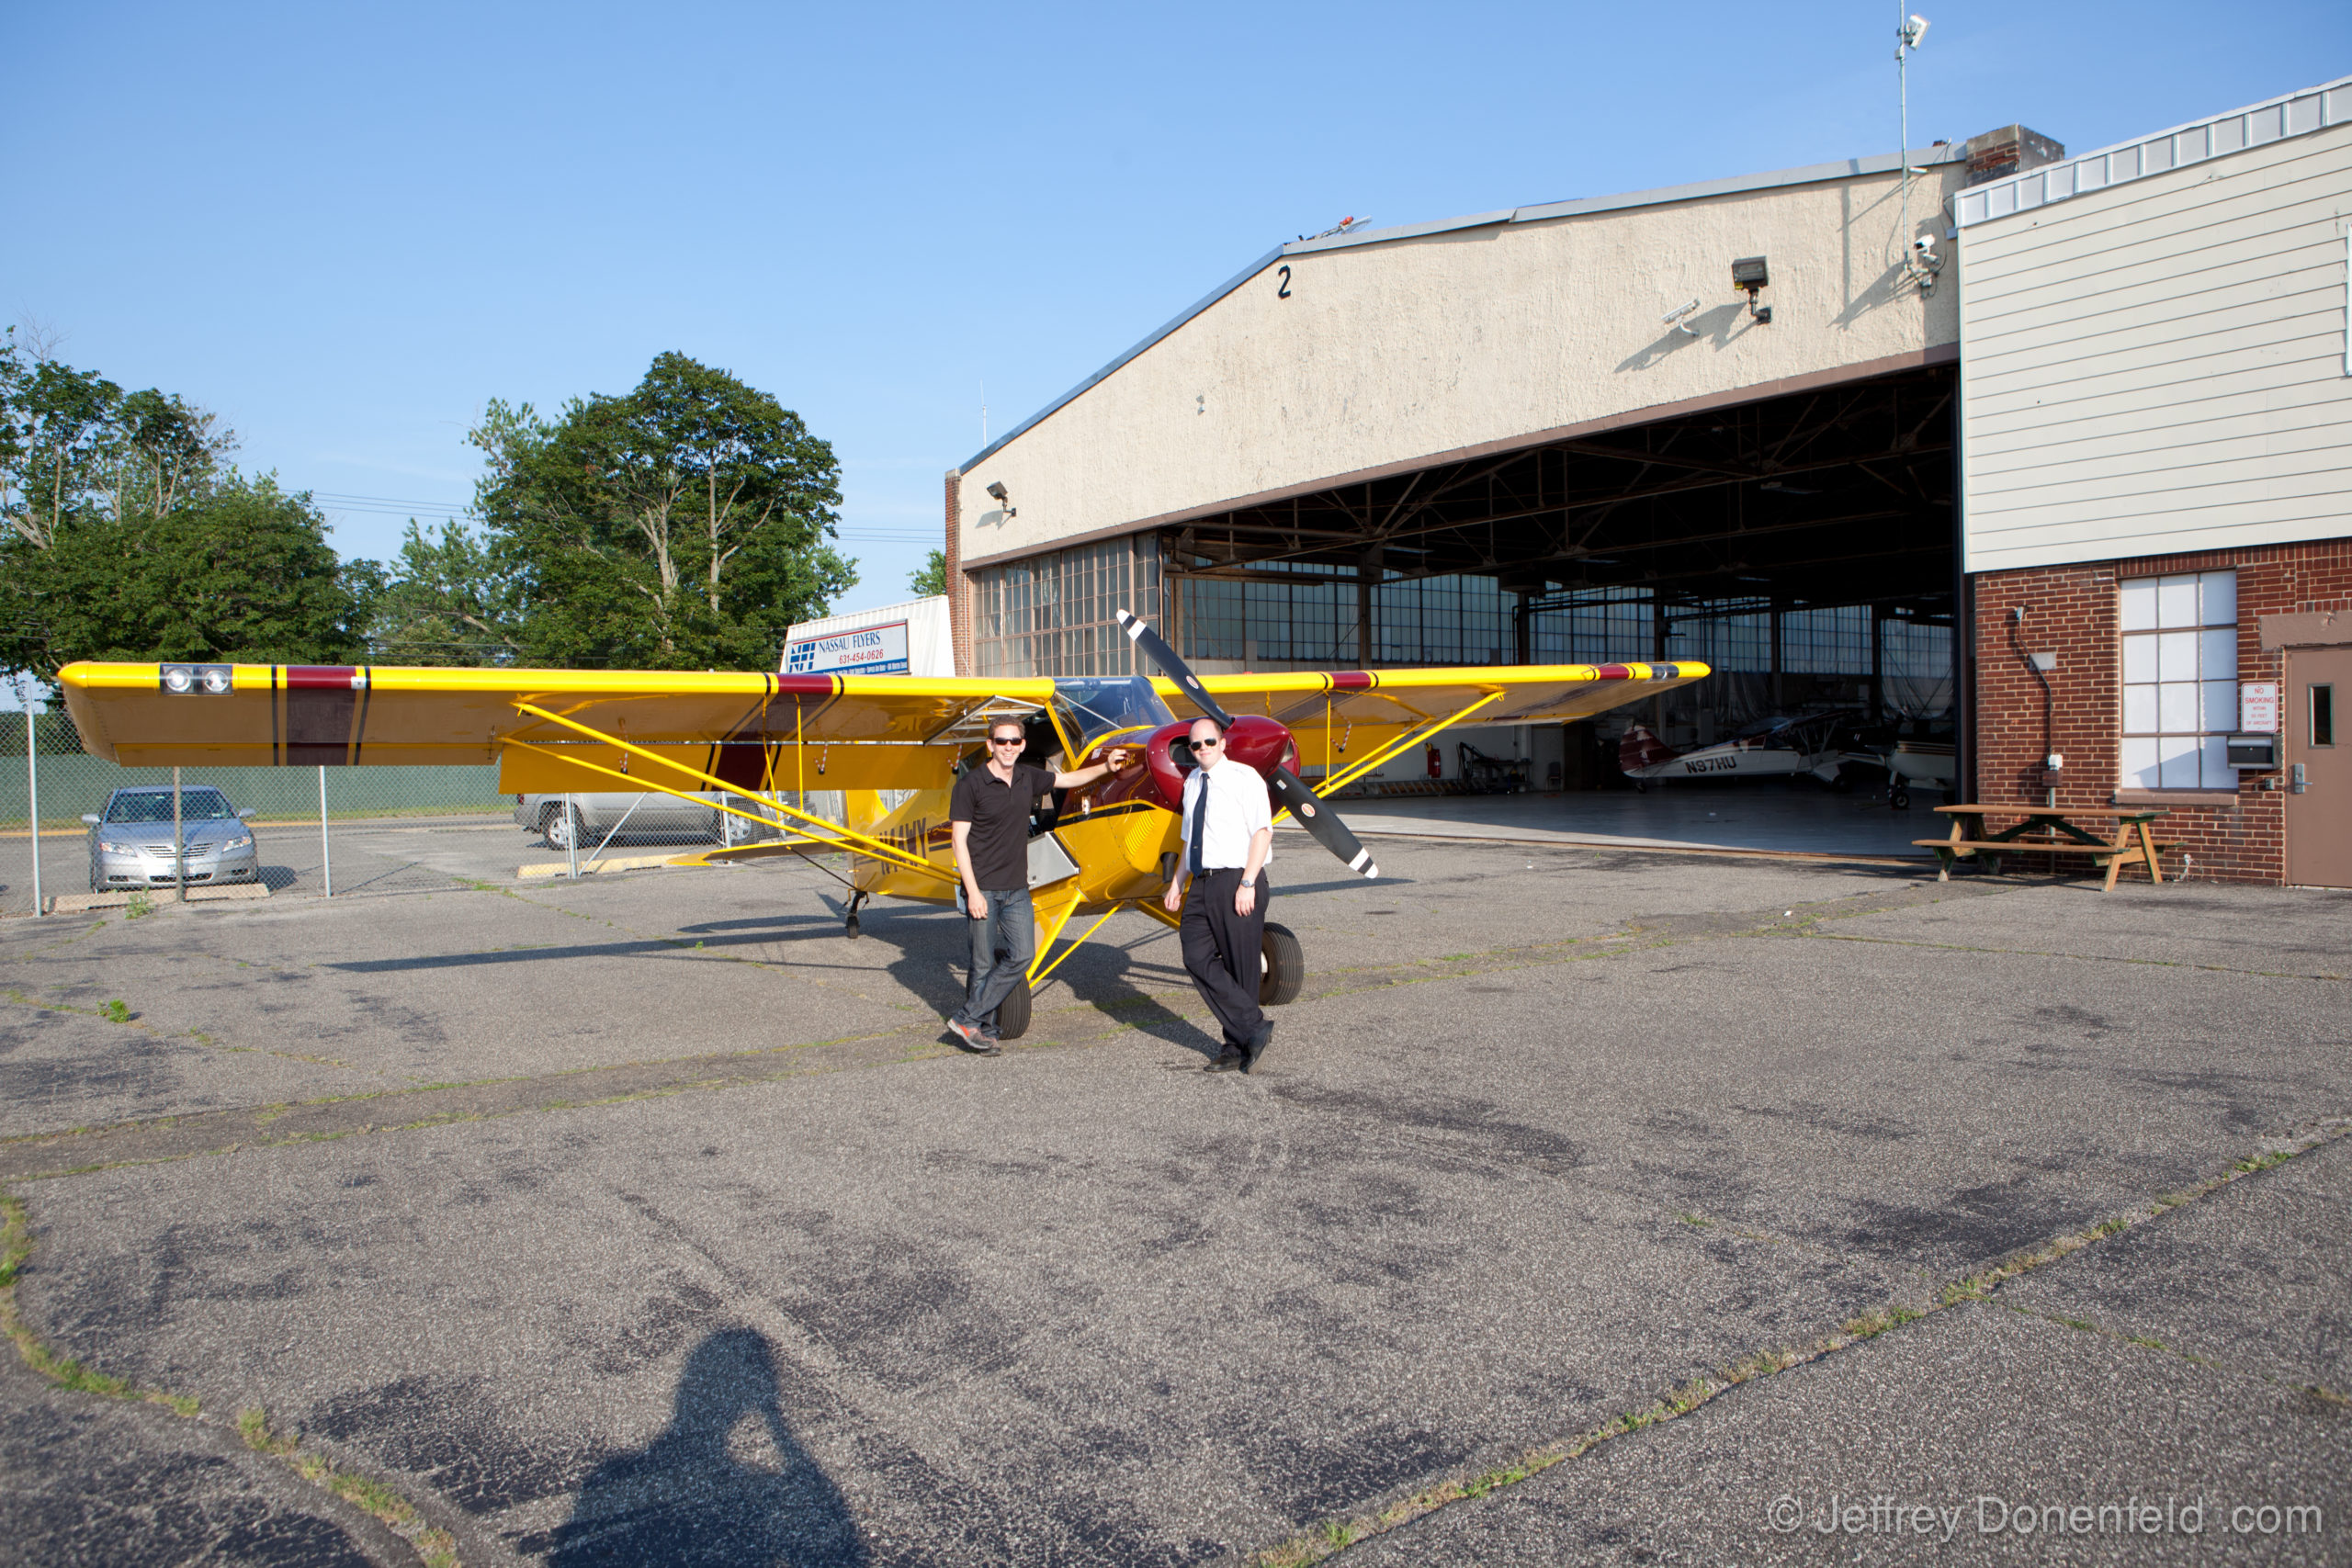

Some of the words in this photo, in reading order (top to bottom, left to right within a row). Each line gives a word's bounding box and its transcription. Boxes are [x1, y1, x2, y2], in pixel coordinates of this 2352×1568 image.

[1278, 265, 1291, 299] 2
[819, 637, 850, 653] NASSAU
[853, 631, 880, 649] FLYERS
[839, 649, 884, 664] 631-454-0626
[1684, 756, 1736, 773] N97HU
